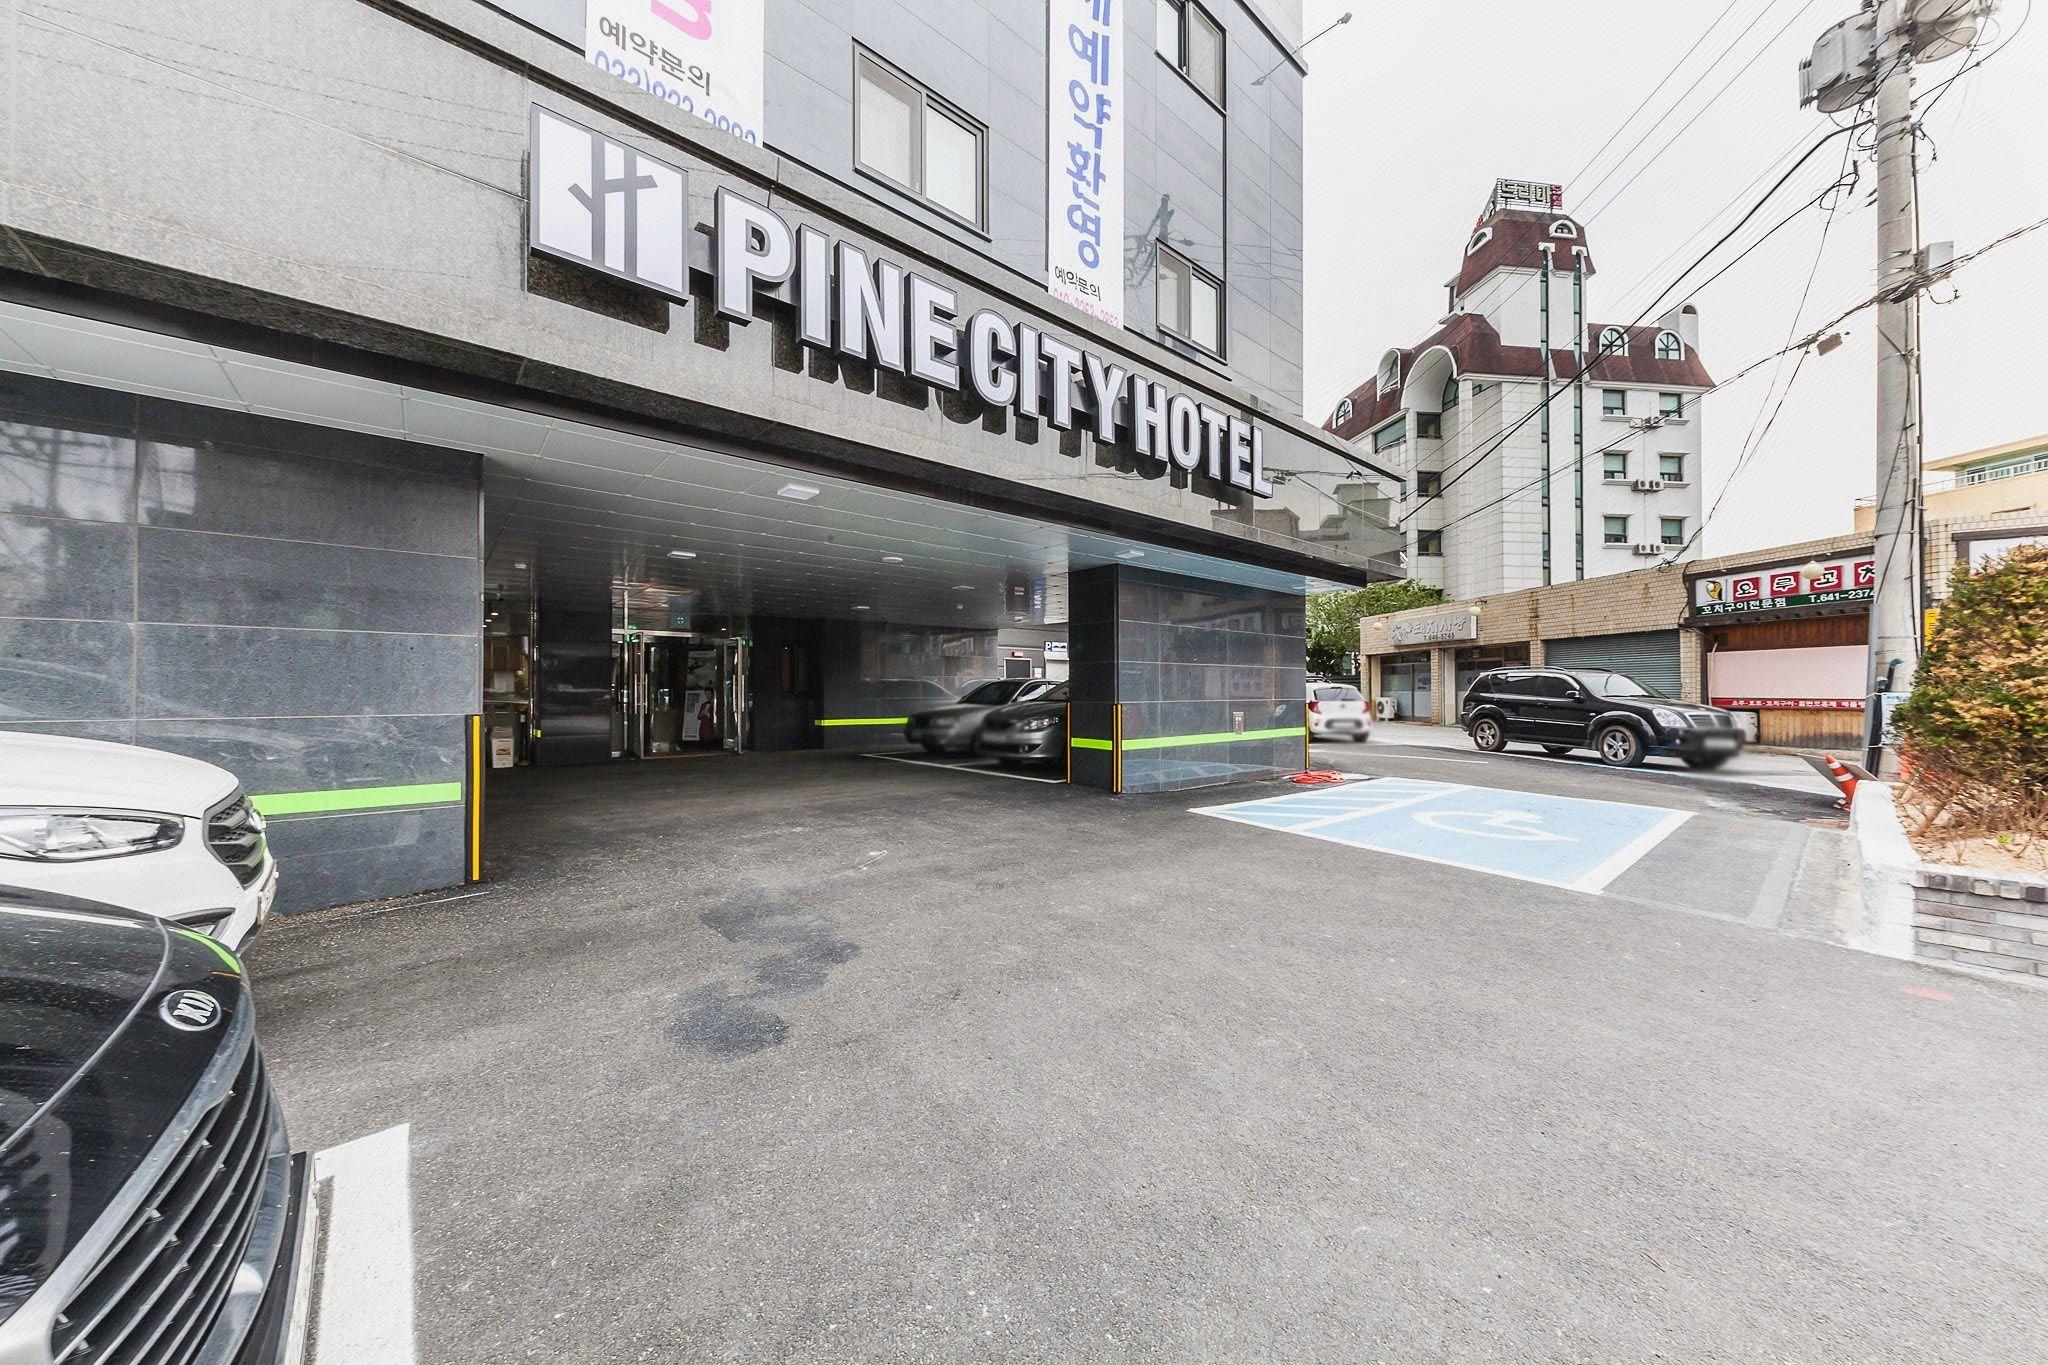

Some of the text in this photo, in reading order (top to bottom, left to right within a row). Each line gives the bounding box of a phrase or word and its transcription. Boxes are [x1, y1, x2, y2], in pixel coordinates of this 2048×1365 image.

[599, 15, 711, 97] 예약문의
[714, 184, 1275, 500] PINE CITY HOTEL
[1701, 596, 1787, 615] 꼬치구이전문점
